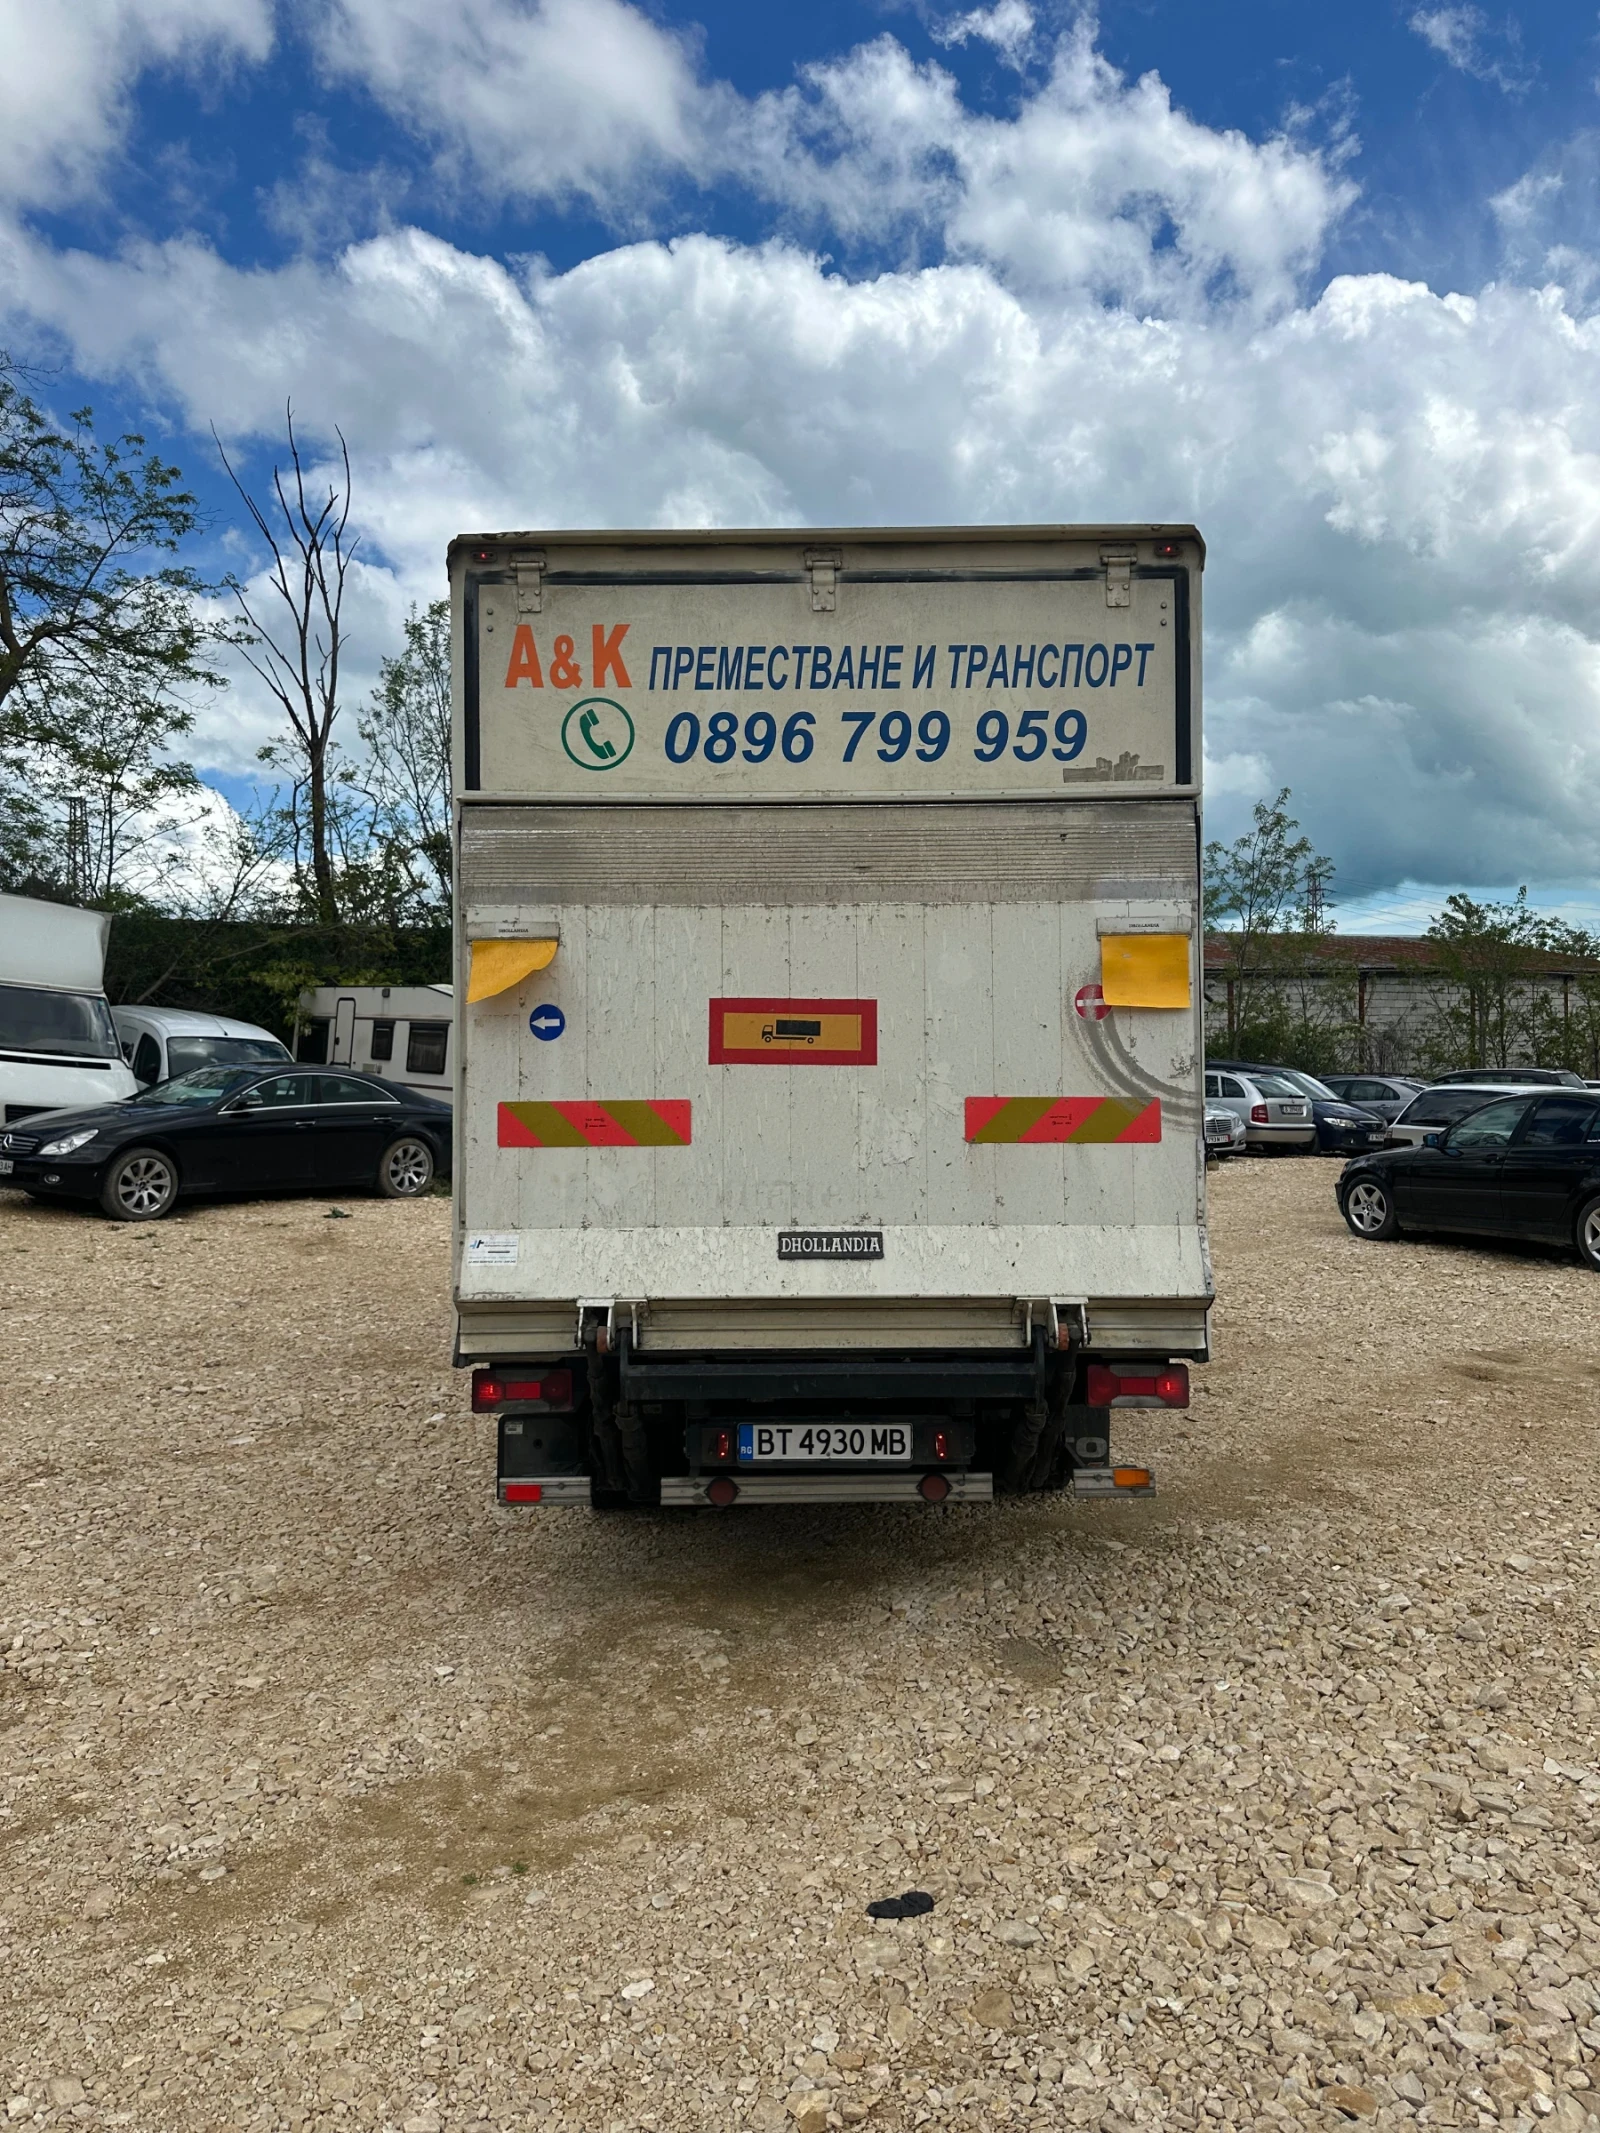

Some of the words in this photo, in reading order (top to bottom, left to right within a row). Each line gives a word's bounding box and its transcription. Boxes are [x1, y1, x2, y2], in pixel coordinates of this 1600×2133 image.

[505, 624, 632, 688] A&K
[649, 645, 903, 690] ПРЕМЕСТВАНЕ
[913, 646, 937, 689] И
[948, 643, 1155, 687] ТРАНСПОРТ
[664, 711, 815, 764] 0896
[841, 711, 950, 763] 799
[975, 709, 1087, 762] 959
[781, 1237, 880, 1253] DHOLLANDIA
[740, 1446, 752, 1454] BG
[757, 1428, 793, 1455] BT
[799, 1428, 865, 1455] 4930
[871, 1428, 906, 1455] MB
